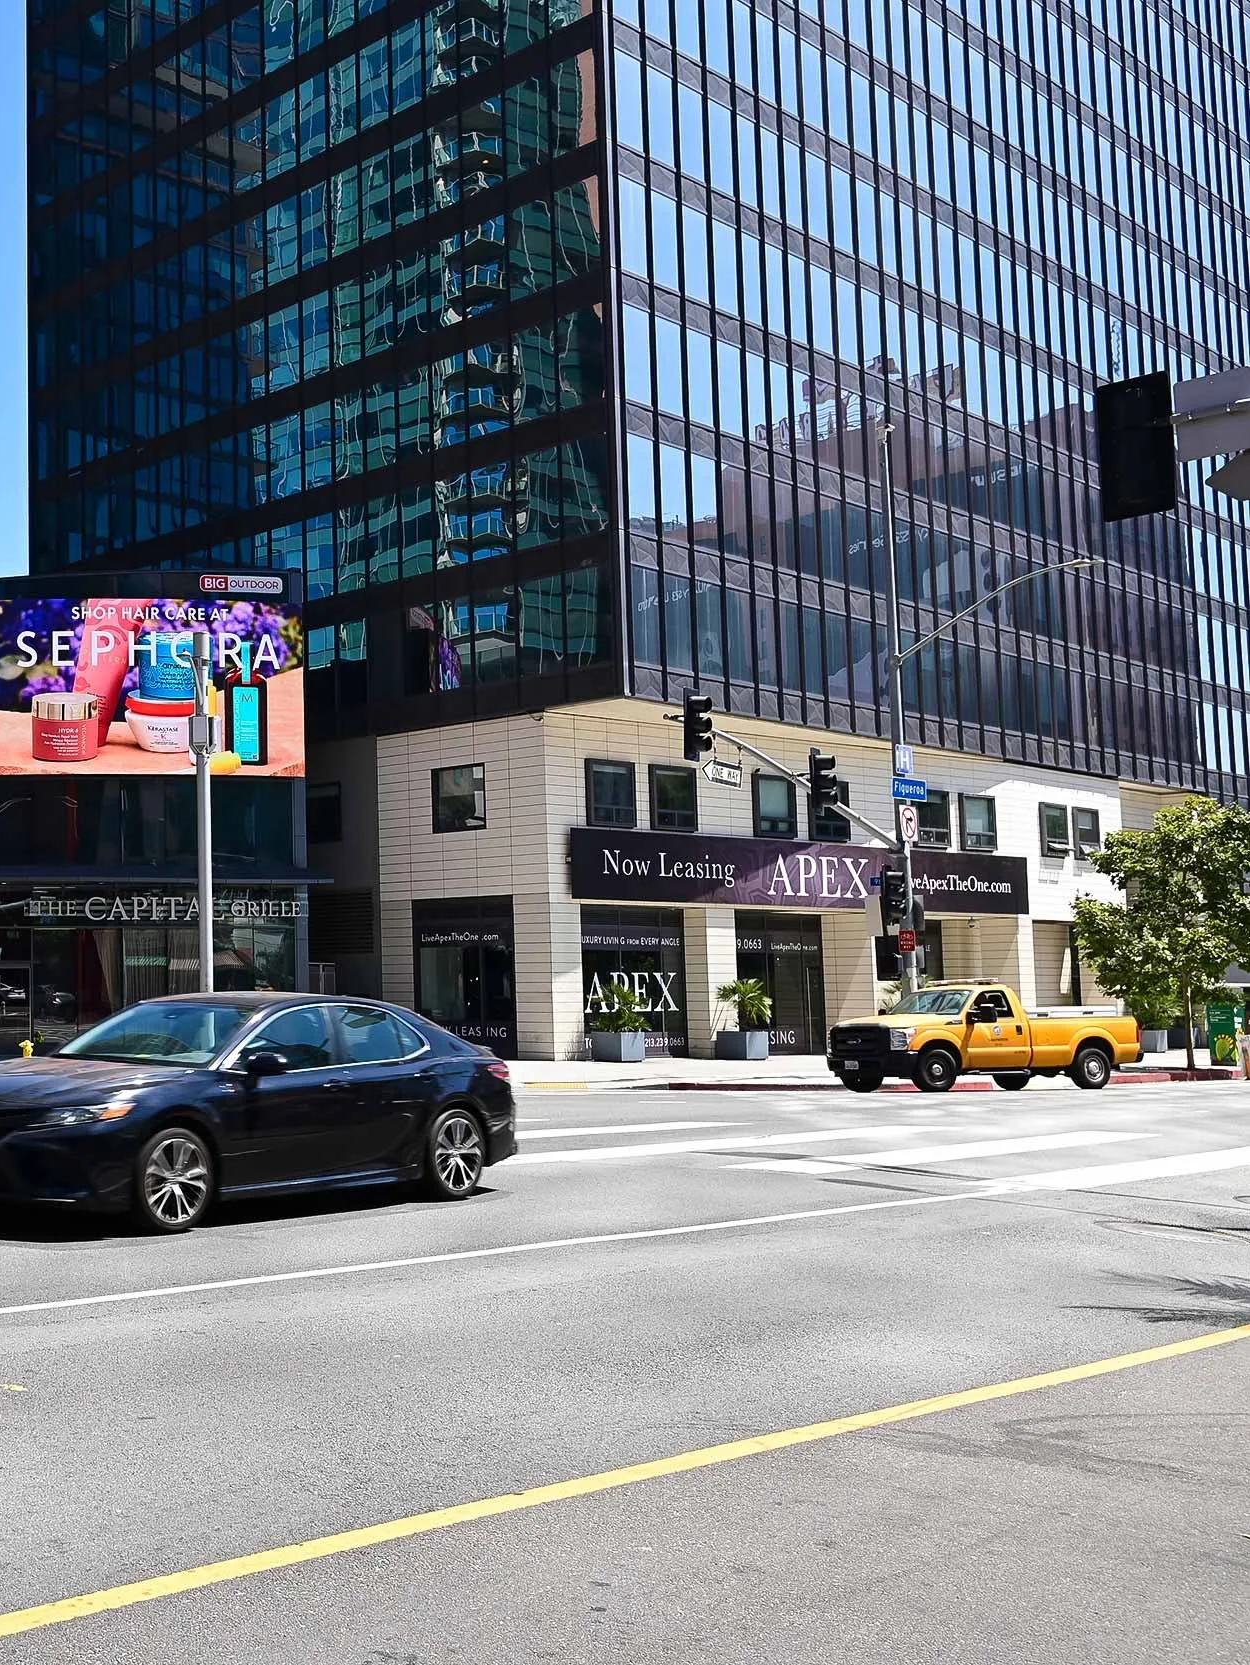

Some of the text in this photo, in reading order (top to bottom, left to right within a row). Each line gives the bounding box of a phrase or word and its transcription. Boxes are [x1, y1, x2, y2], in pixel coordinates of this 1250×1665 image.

[204, 577, 279, 590] BIG OUTDOOR
[71, 606, 229, 622] SHOP HAIR CARE AT
[711, 765, 739, 781] ONE WAY
[893, 781, 925, 798] Figueroa
[602, 849, 735, 888] Now Leasing
[767, 854, 869, 899] APEX
[910, 873, 1012, 895] veApexTheOne.com
[34, 900, 77, 916] THE
[230, 900, 301, 918] GRILLE
[581, 935, 602, 944] UXURY
[640, 937, 659, 946] EVERY
[660, 937, 680, 946] ANGLE
[736, 938, 762, 950] 9.0663
[584, 971, 680, 1014] APEX
[769, 1030, 796, 1045] SING
